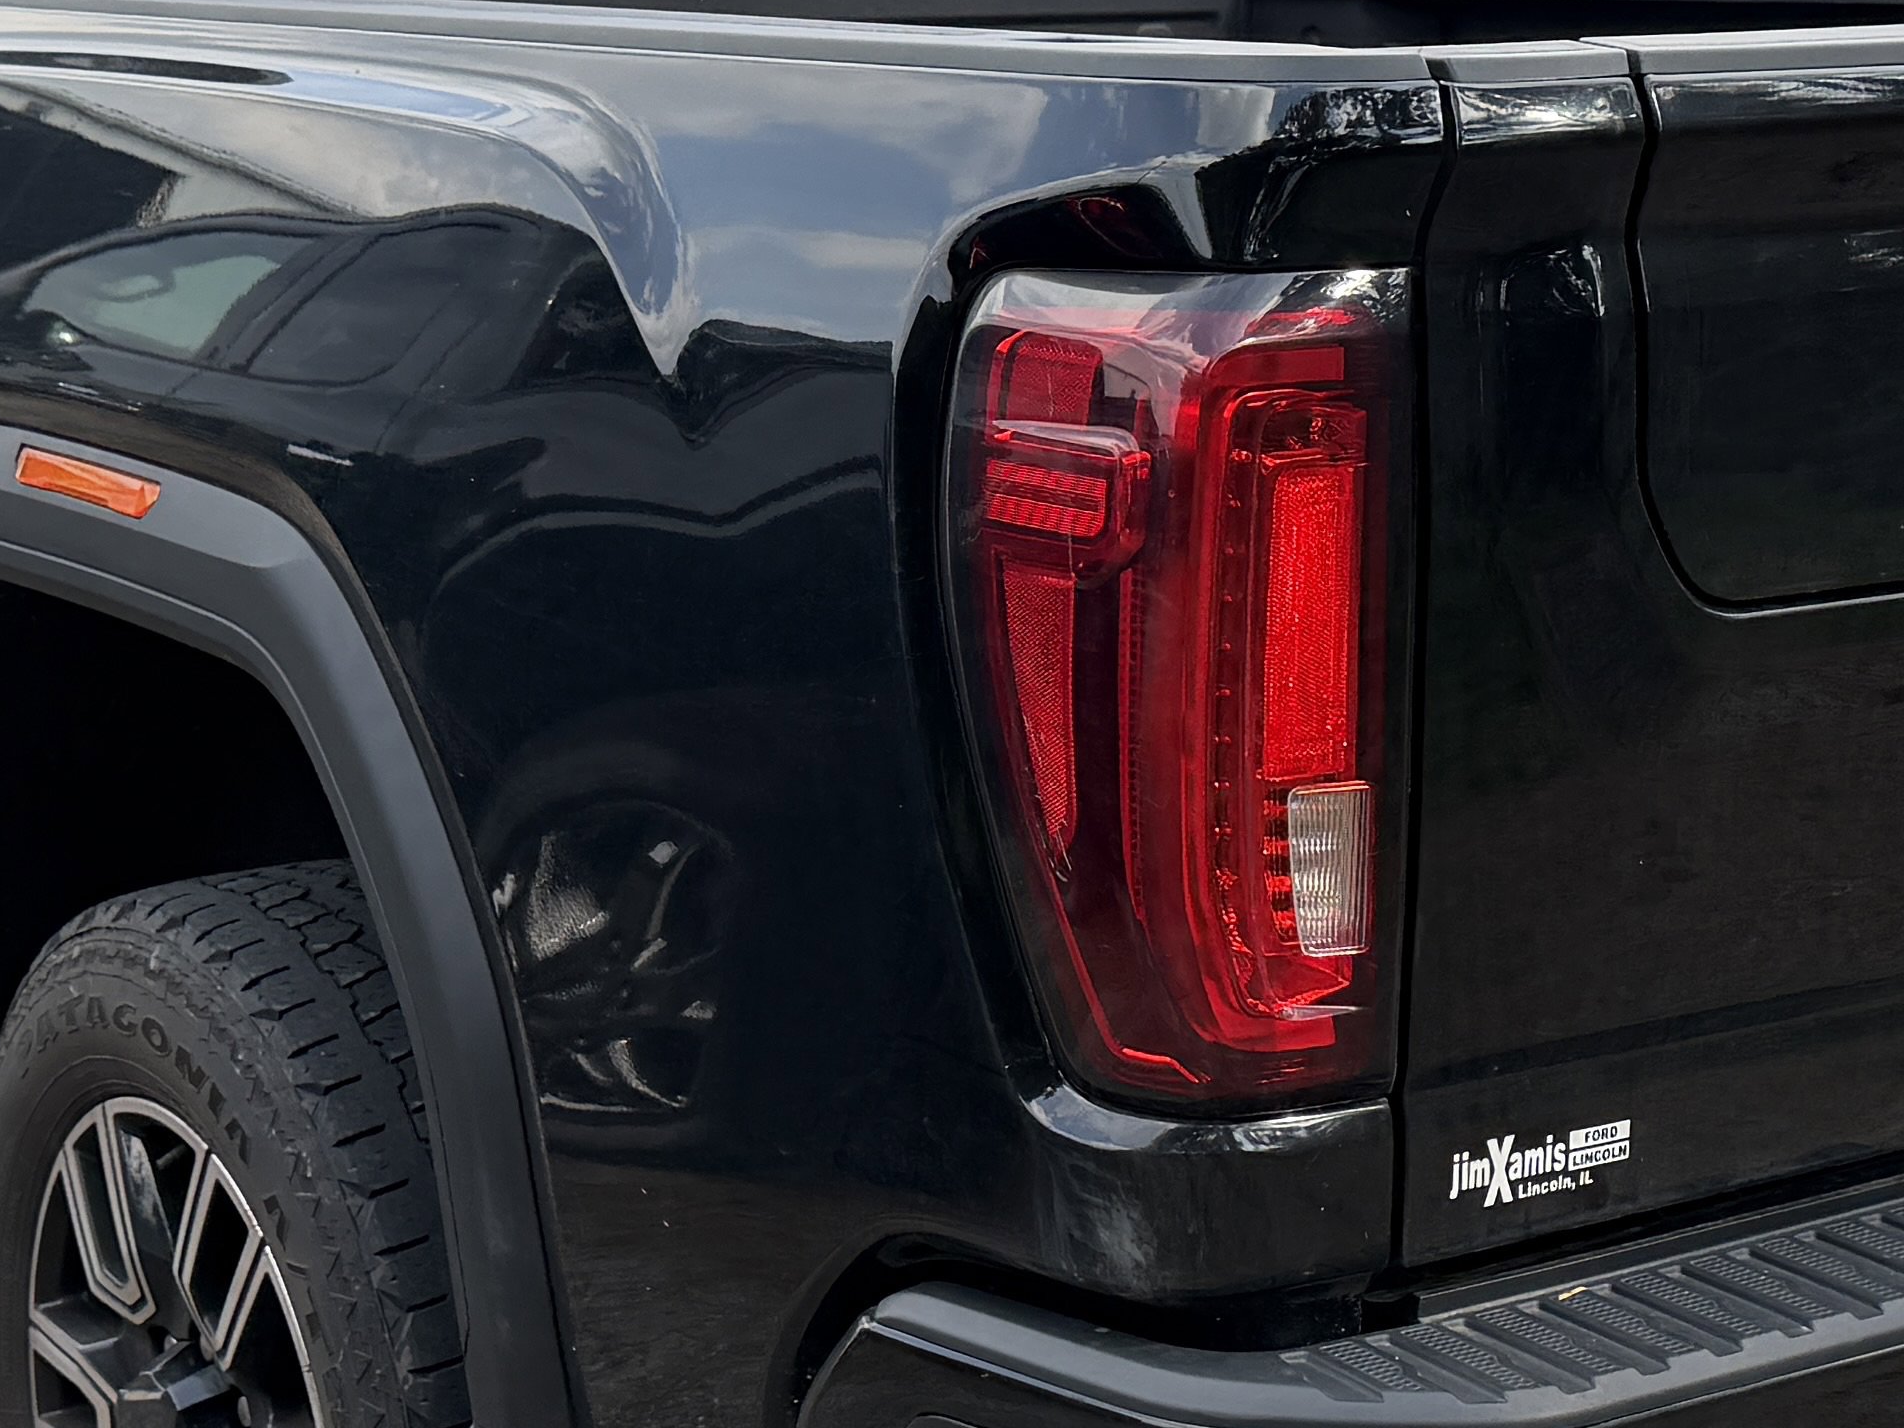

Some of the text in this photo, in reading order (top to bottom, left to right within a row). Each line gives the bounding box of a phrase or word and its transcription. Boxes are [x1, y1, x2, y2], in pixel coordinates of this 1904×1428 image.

[1584, 1125, 1618, 1143] FORD
[1572, 1145, 1628, 1167] LINCOLN
[1518, 1170, 1594, 1199] Lincoln, IL
